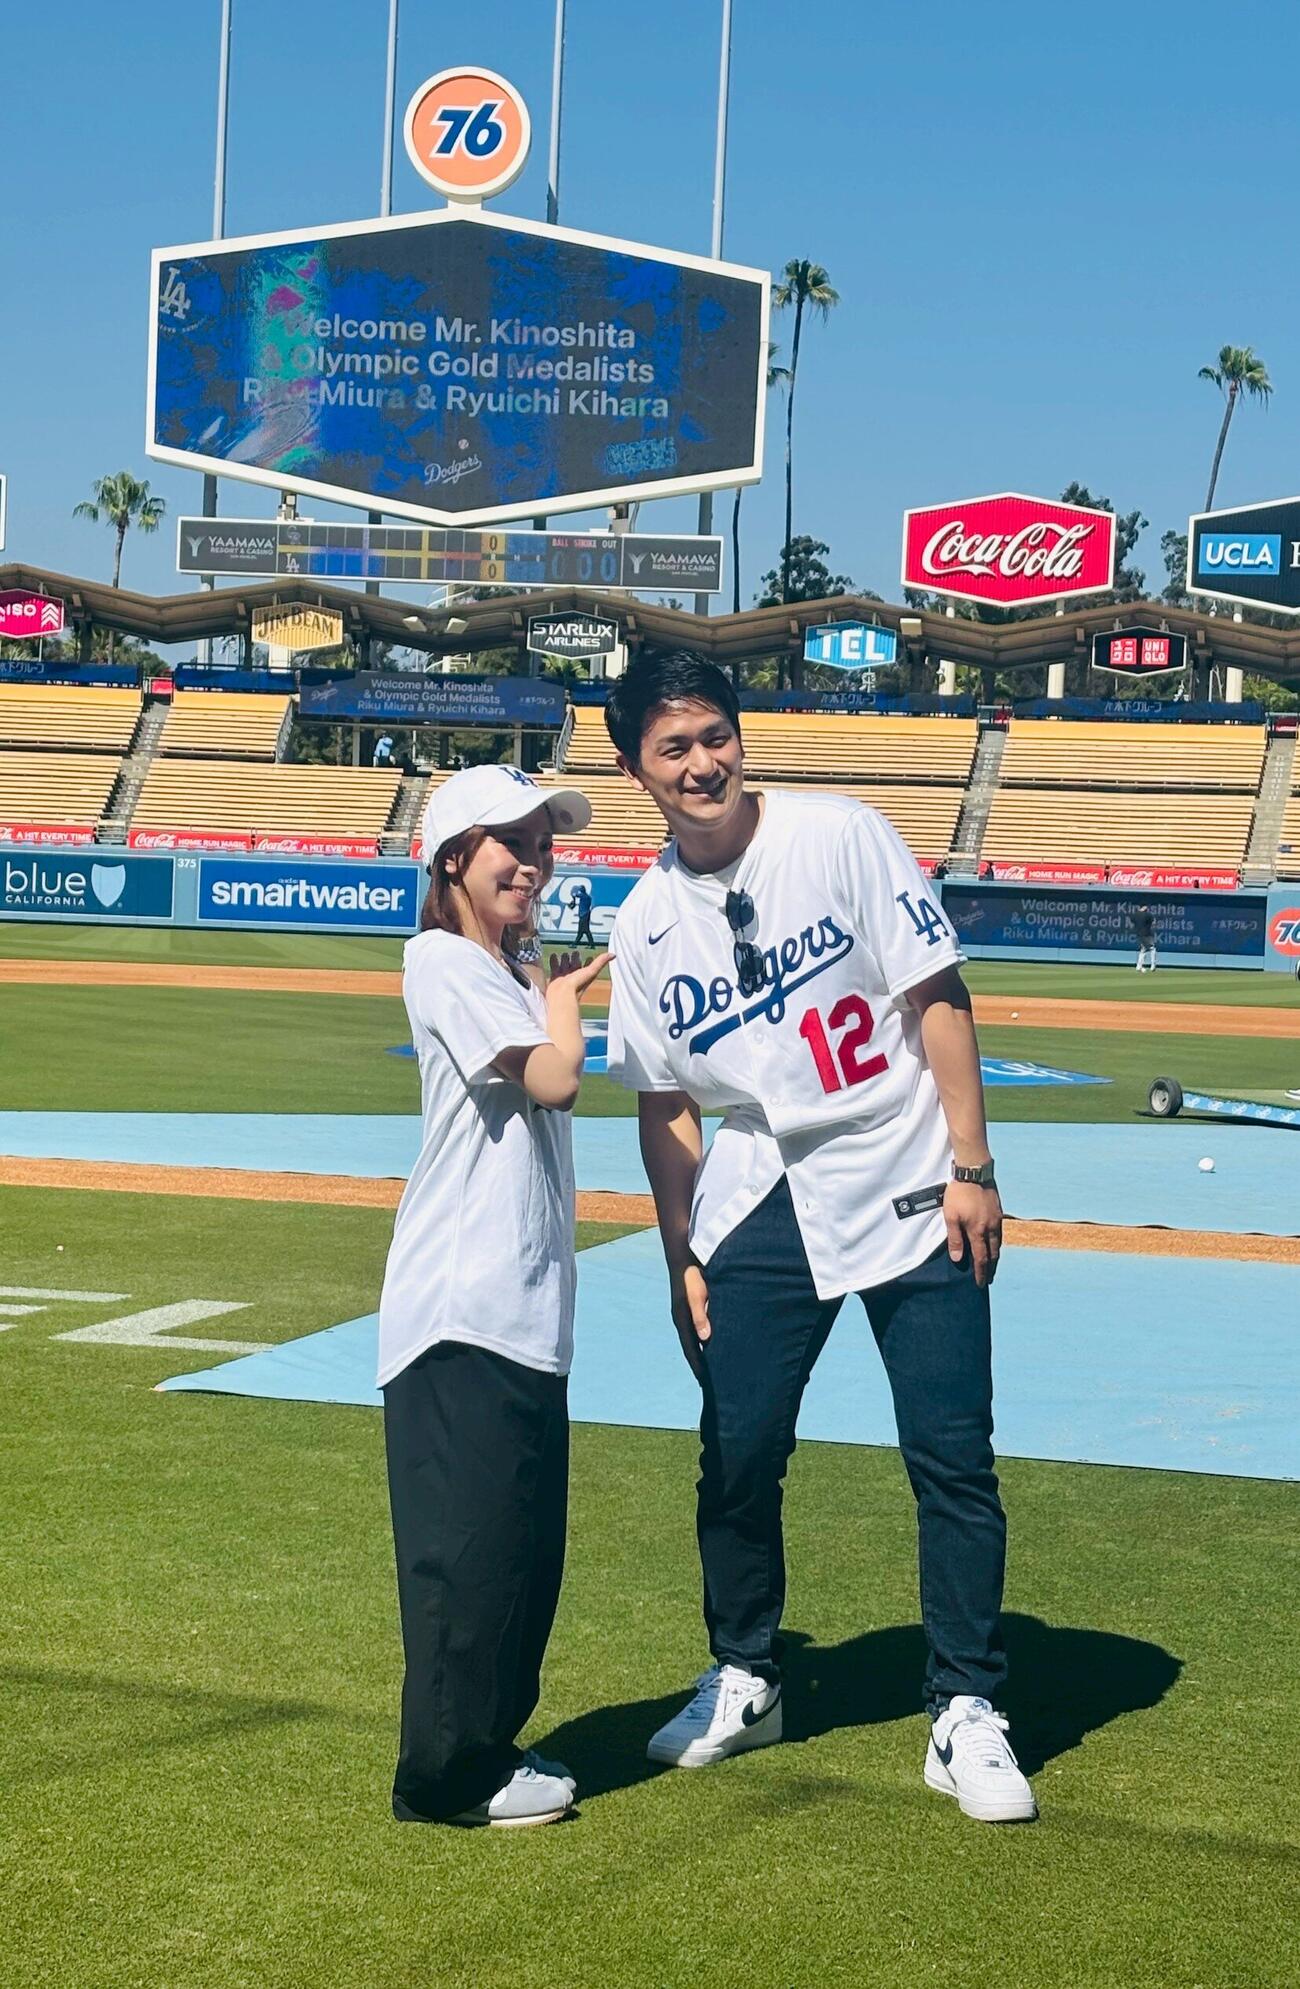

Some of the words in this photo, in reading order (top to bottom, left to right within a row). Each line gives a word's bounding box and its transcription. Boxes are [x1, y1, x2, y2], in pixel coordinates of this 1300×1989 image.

[431, 100, 505, 160] 76
[160, 267, 191, 319] LA
[282, 312, 427, 342] Welcome
[435, 316, 482, 343] Mr.
[490, 318, 636, 348] Kinoshita
[292, 345, 420, 379] Olympic
[428, 350, 498, 378] Gold
[507, 353, 655, 384] Medalists
[319, 380, 405, 409] Miura
[415, 384, 436, 410] &
[447, 385, 560, 418] Ryuichi
[568, 389, 669, 418] Kihara
[424, 454, 482, 485] Dodgers
[489, 535, 497, 550] 0
[552, 539, 568, 547] BALL
[574, 540, 597, 548] STRIKE
[602, 540, 617, 549] OUT
[922, 521, 1095, 578] Coca-Cola
[1206, 542, 1273, 566] UCLA
[285, 553, 300, 573] LA
[600, 552, 617, 582] 0
[652, 563, 679, 571] RESORT
[488, 564, 497, 579] 0
[258, 611, 287, 638] JIM
[291, 606, 334, 639] BEAM
[532, 622, 613, 638] STARLUX
[544, 636, 601, 647] AIRLINES
[816, 628, 885, 661] TEL
[1144, 640, 1164, 650] UNI
[1144, 652, 1165, 662] QLO
[371, 679, 422, 690] Welcome
[424, 681, 440, 691] Mr.
[443, 682, 493, 693] Kinoshita
[363, 690, 371, 699] &
[375, 690, 420, 702] Olympic
[422, 691, 447, 701] Gold
[449, 693, 501, 704] Medalists
[358, 700, 381, 710] Riku
[384, 701, 414, 712] Miura
[417, 703, 425, 712] &
[428, 703, 468, 715] Ryuichi
[470, 705, 505, 715] Kihara
[24, 832, 39, 840] HIT
[40, 833, 68, 841] EVERY
[70, 834, 92, 842] TIME
[178, 838, 202, 846] HOME
[204, 839, 220, 847] RUN
[221, 840, 247, 848] MAGIC
[326, 845, 353, 853] EVERY
[177, 859, 196, 868] 375
[607, 855, 635, 863] EVERY
[5, 861, 86, 895] blue
[991, 865, 1027, 880] oca-Cola
[1111, 870, 1154, 886] Coca-Cola
[1156, 875, 1164, 883] A
[1165, 875, 1179, 883] HIT
[1212, 877, 1233, 885] TIME
[5, 894, 85, 906] CALIFORNIA
[212, 879, 405, 911] smartwater
[1021, 898, 1088, 912] Welcome
[1091, 901, 1113, 913] Mr.
[1117, 902, 1185, 915] Kinshita
[896, 890, 949, 946] LA
[1010, 912, 1021, 924] &
[1026, 912, 1084, 928] Olympic
[1089, 913, 1121, 927] Gold
[1003, 926, 1034, 940] Riku
[1038, 927, 1078, 941] Miura
[1082, 928, 1092, 941] &
[1154, 931, 1200, 945] Kihara
[800, 994, 889, 1094] 12
